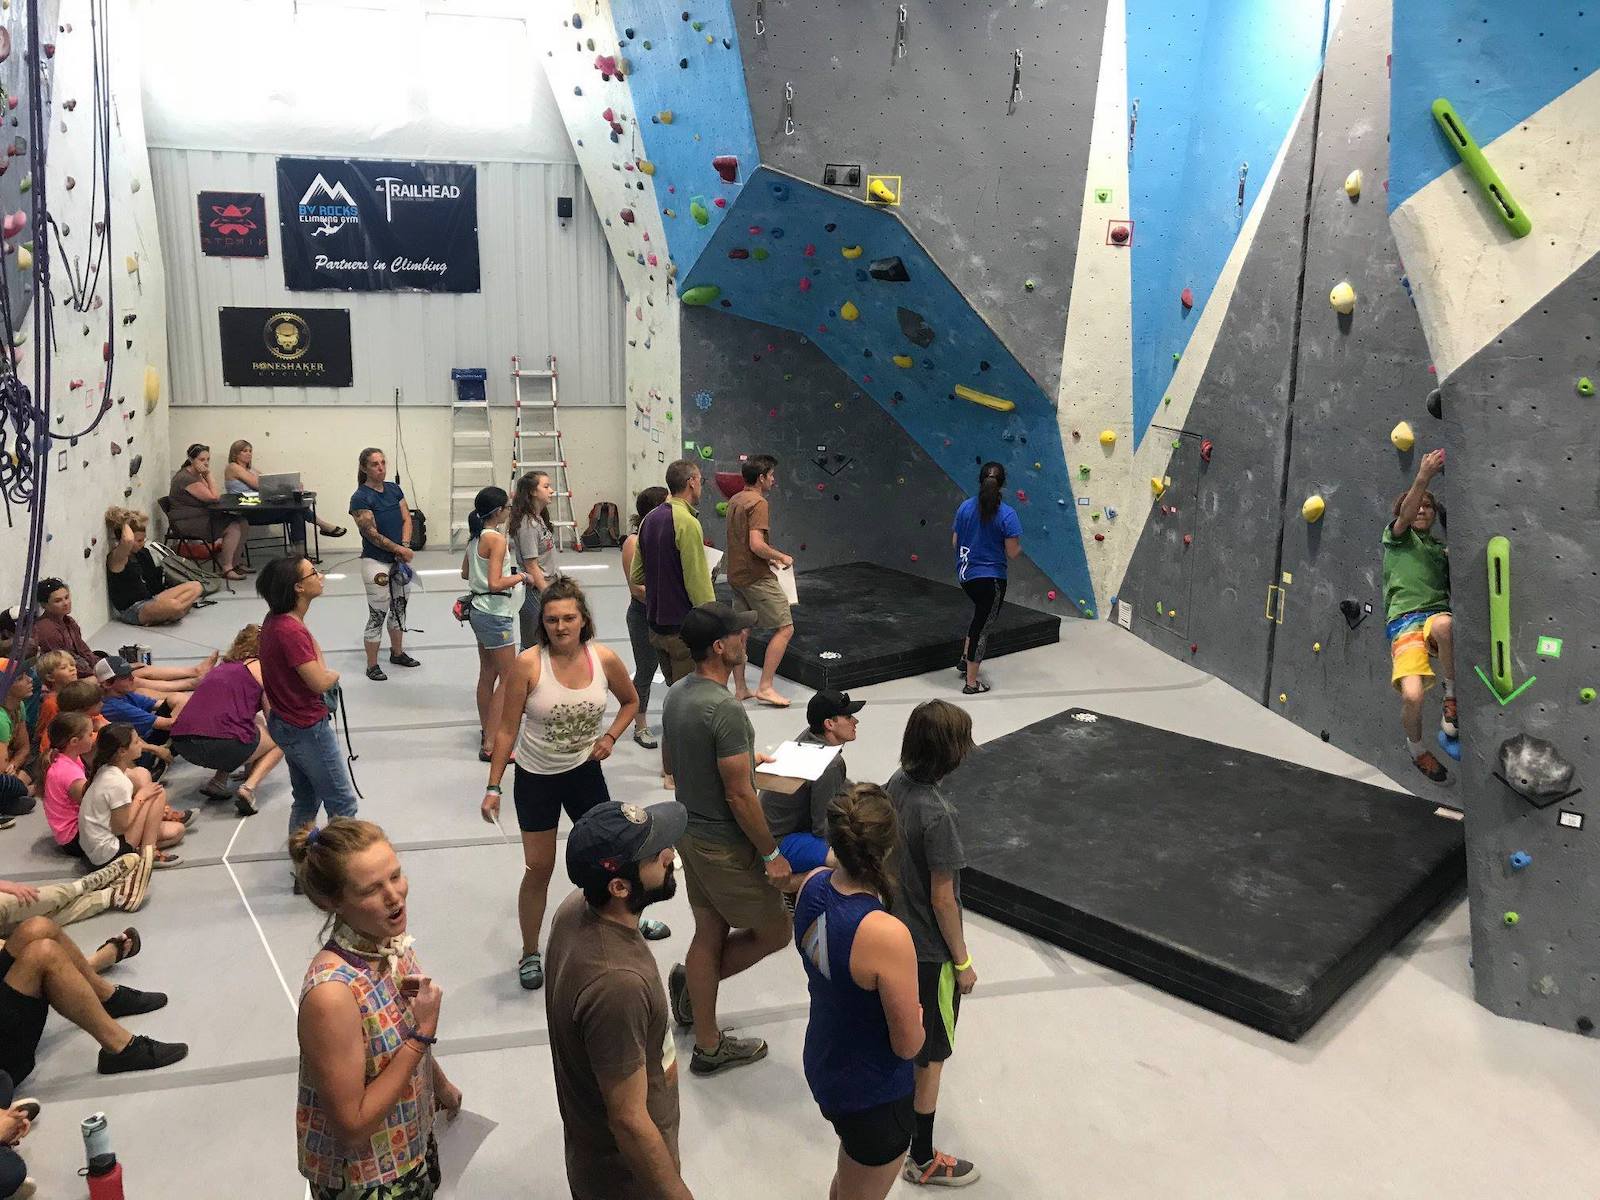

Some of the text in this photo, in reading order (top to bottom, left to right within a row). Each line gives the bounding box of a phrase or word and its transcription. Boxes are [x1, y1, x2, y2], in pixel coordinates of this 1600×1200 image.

[375, 176, 461, 223] TRAILHEAD
[320, 205, 358, 216] ROCKS
[299, 215, 338, 223] CLIMBING
[315, 254, 447, 276] Partners in Climbing
[252, 362, 326, 372] BONESHAKER
